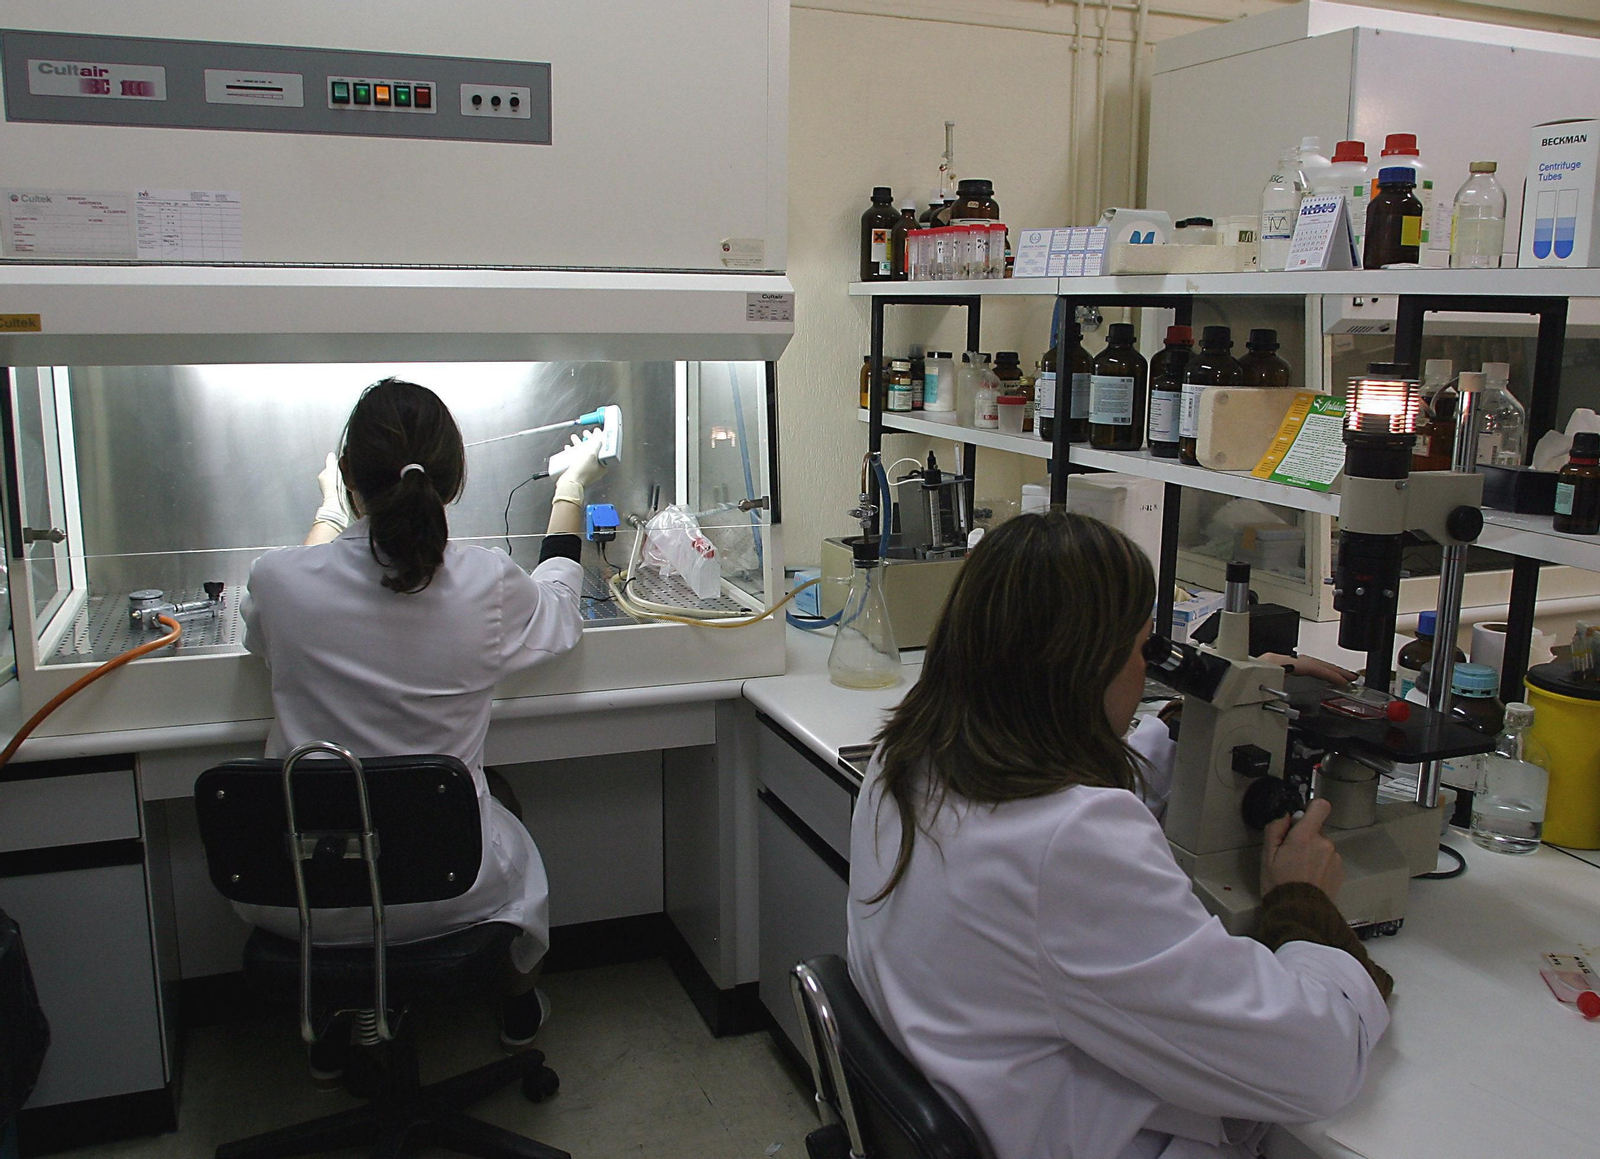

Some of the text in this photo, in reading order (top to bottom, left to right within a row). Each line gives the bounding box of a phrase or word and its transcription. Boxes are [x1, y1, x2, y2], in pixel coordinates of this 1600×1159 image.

[37, 62, 110, 78] Cultair
[1541, 134, 1587, 146] BECKMAN
[1538, 161, 1581, 172] Centrifuge
[1538, 173, 1562, 181] Tubes
[20, 194, 53, 204] Cultek
